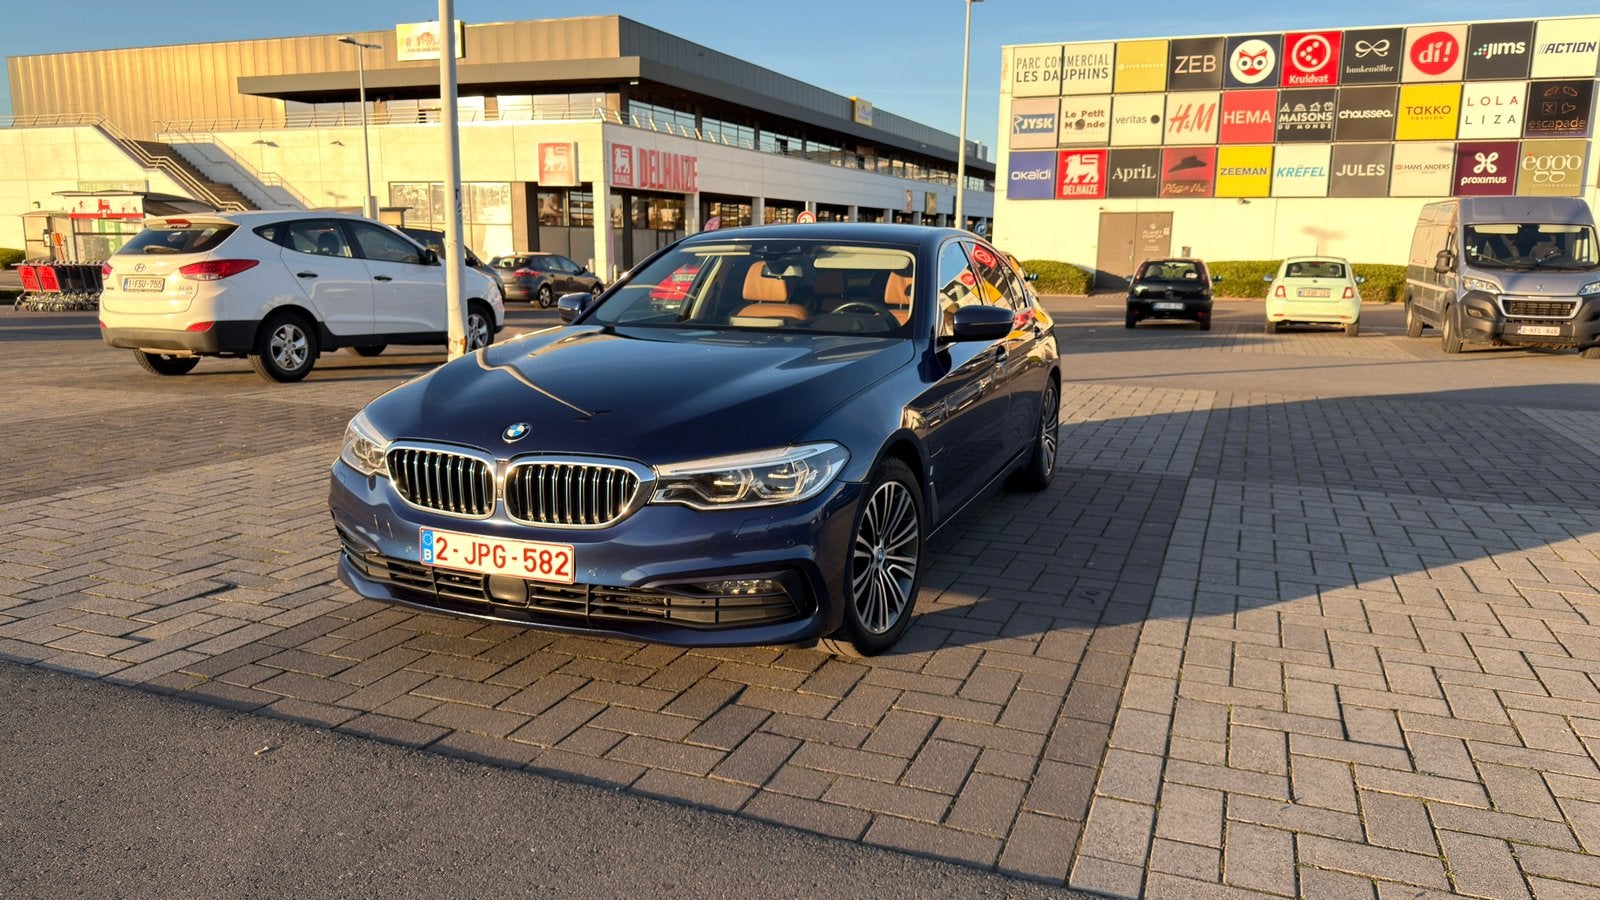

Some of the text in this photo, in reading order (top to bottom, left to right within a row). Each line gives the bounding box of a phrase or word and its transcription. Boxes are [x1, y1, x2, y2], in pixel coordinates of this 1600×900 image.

[1485, 41, 1526, 60] jims
[1016, 54, 1109, 70] PARC COMMERCIAL
[1174, 55, 1217, 74] ZEB
[1016, 67, 1109, 82] LES DAUPHINS
[1346, 64, 1394, 74] hunkemöller
[1289, 74, 1329, 84] Kruidvat
[1065, 109, 1105, 119] Le Petit
[1115, 114, 1147, 124] veritas
[1168, 102, 1217, 134] H&M
[1223, 109, 1272, 125] HEMA
[1279, 112, 1333, 123] MAISONS
[1021, 117, 1054, 129] JYSK
[1528, 117, 1586, 130] escapade
[639, 148, 698, 193] DELHAIZE
[1220, 167, 1268, 176] ZEEMAN
[1335, 164, 1386, 176] JULES
[1423, 163, 1451, 171] ANDERS
[1460, 176, 1507, 187] proximus
[1063, 183, 1099, 196] DELHAIZE
[423, 536, 569, 577] B 2-JPG-582
